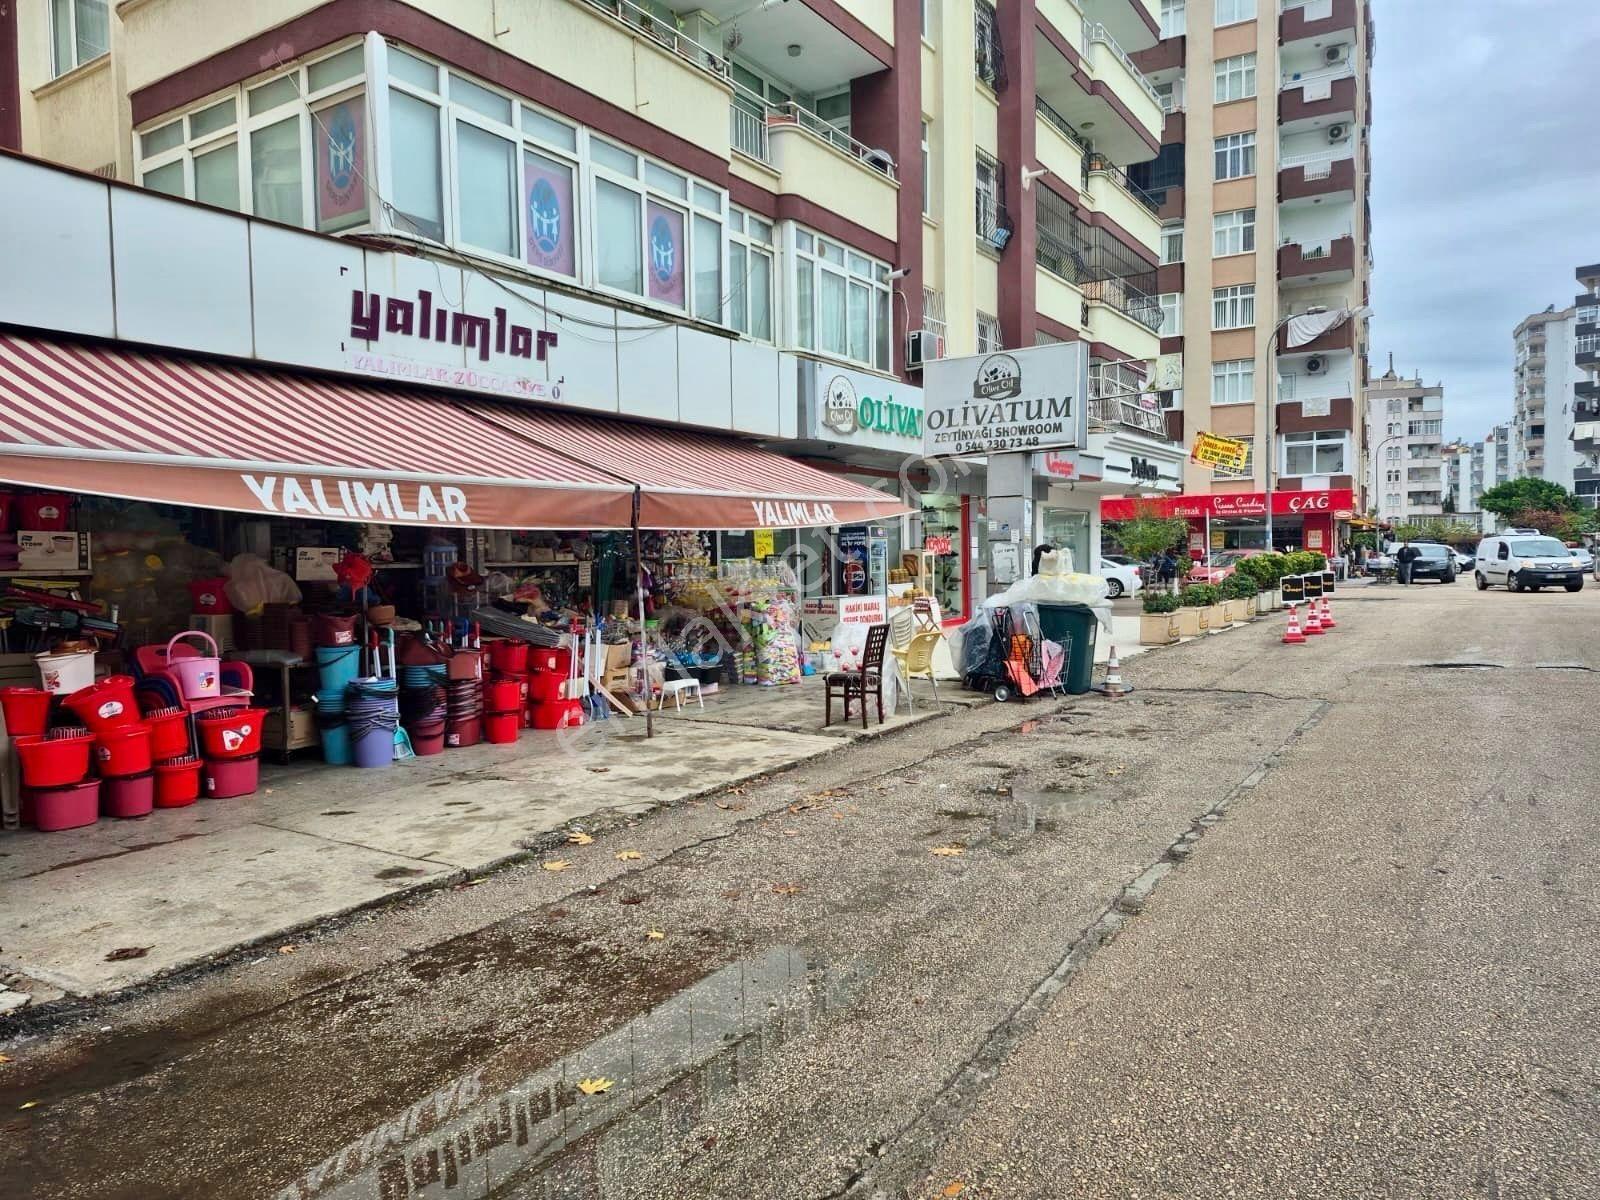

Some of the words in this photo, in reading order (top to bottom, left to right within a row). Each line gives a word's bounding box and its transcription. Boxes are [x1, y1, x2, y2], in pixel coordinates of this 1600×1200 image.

[351, 290, 558, 361] yalımlar
[981, 384, 1000, 395] Olive
[1001, 378, 1014, 389] Oil
[928, 396, 1073, 430] OLİVATUM
[935, 426, 992, 443] ZEYTİNYAĞI
[995, 422, 1063, 439] SHOWROOM
[955, 442, 963, 452] 0
[1009, 437, 1024, 448] 73
[240, 474, 471, 523] YALIMLAR
[1288, 492, 1330, 514] ÇAĞ
[751, 501, 842, 526] YALIMLAR
